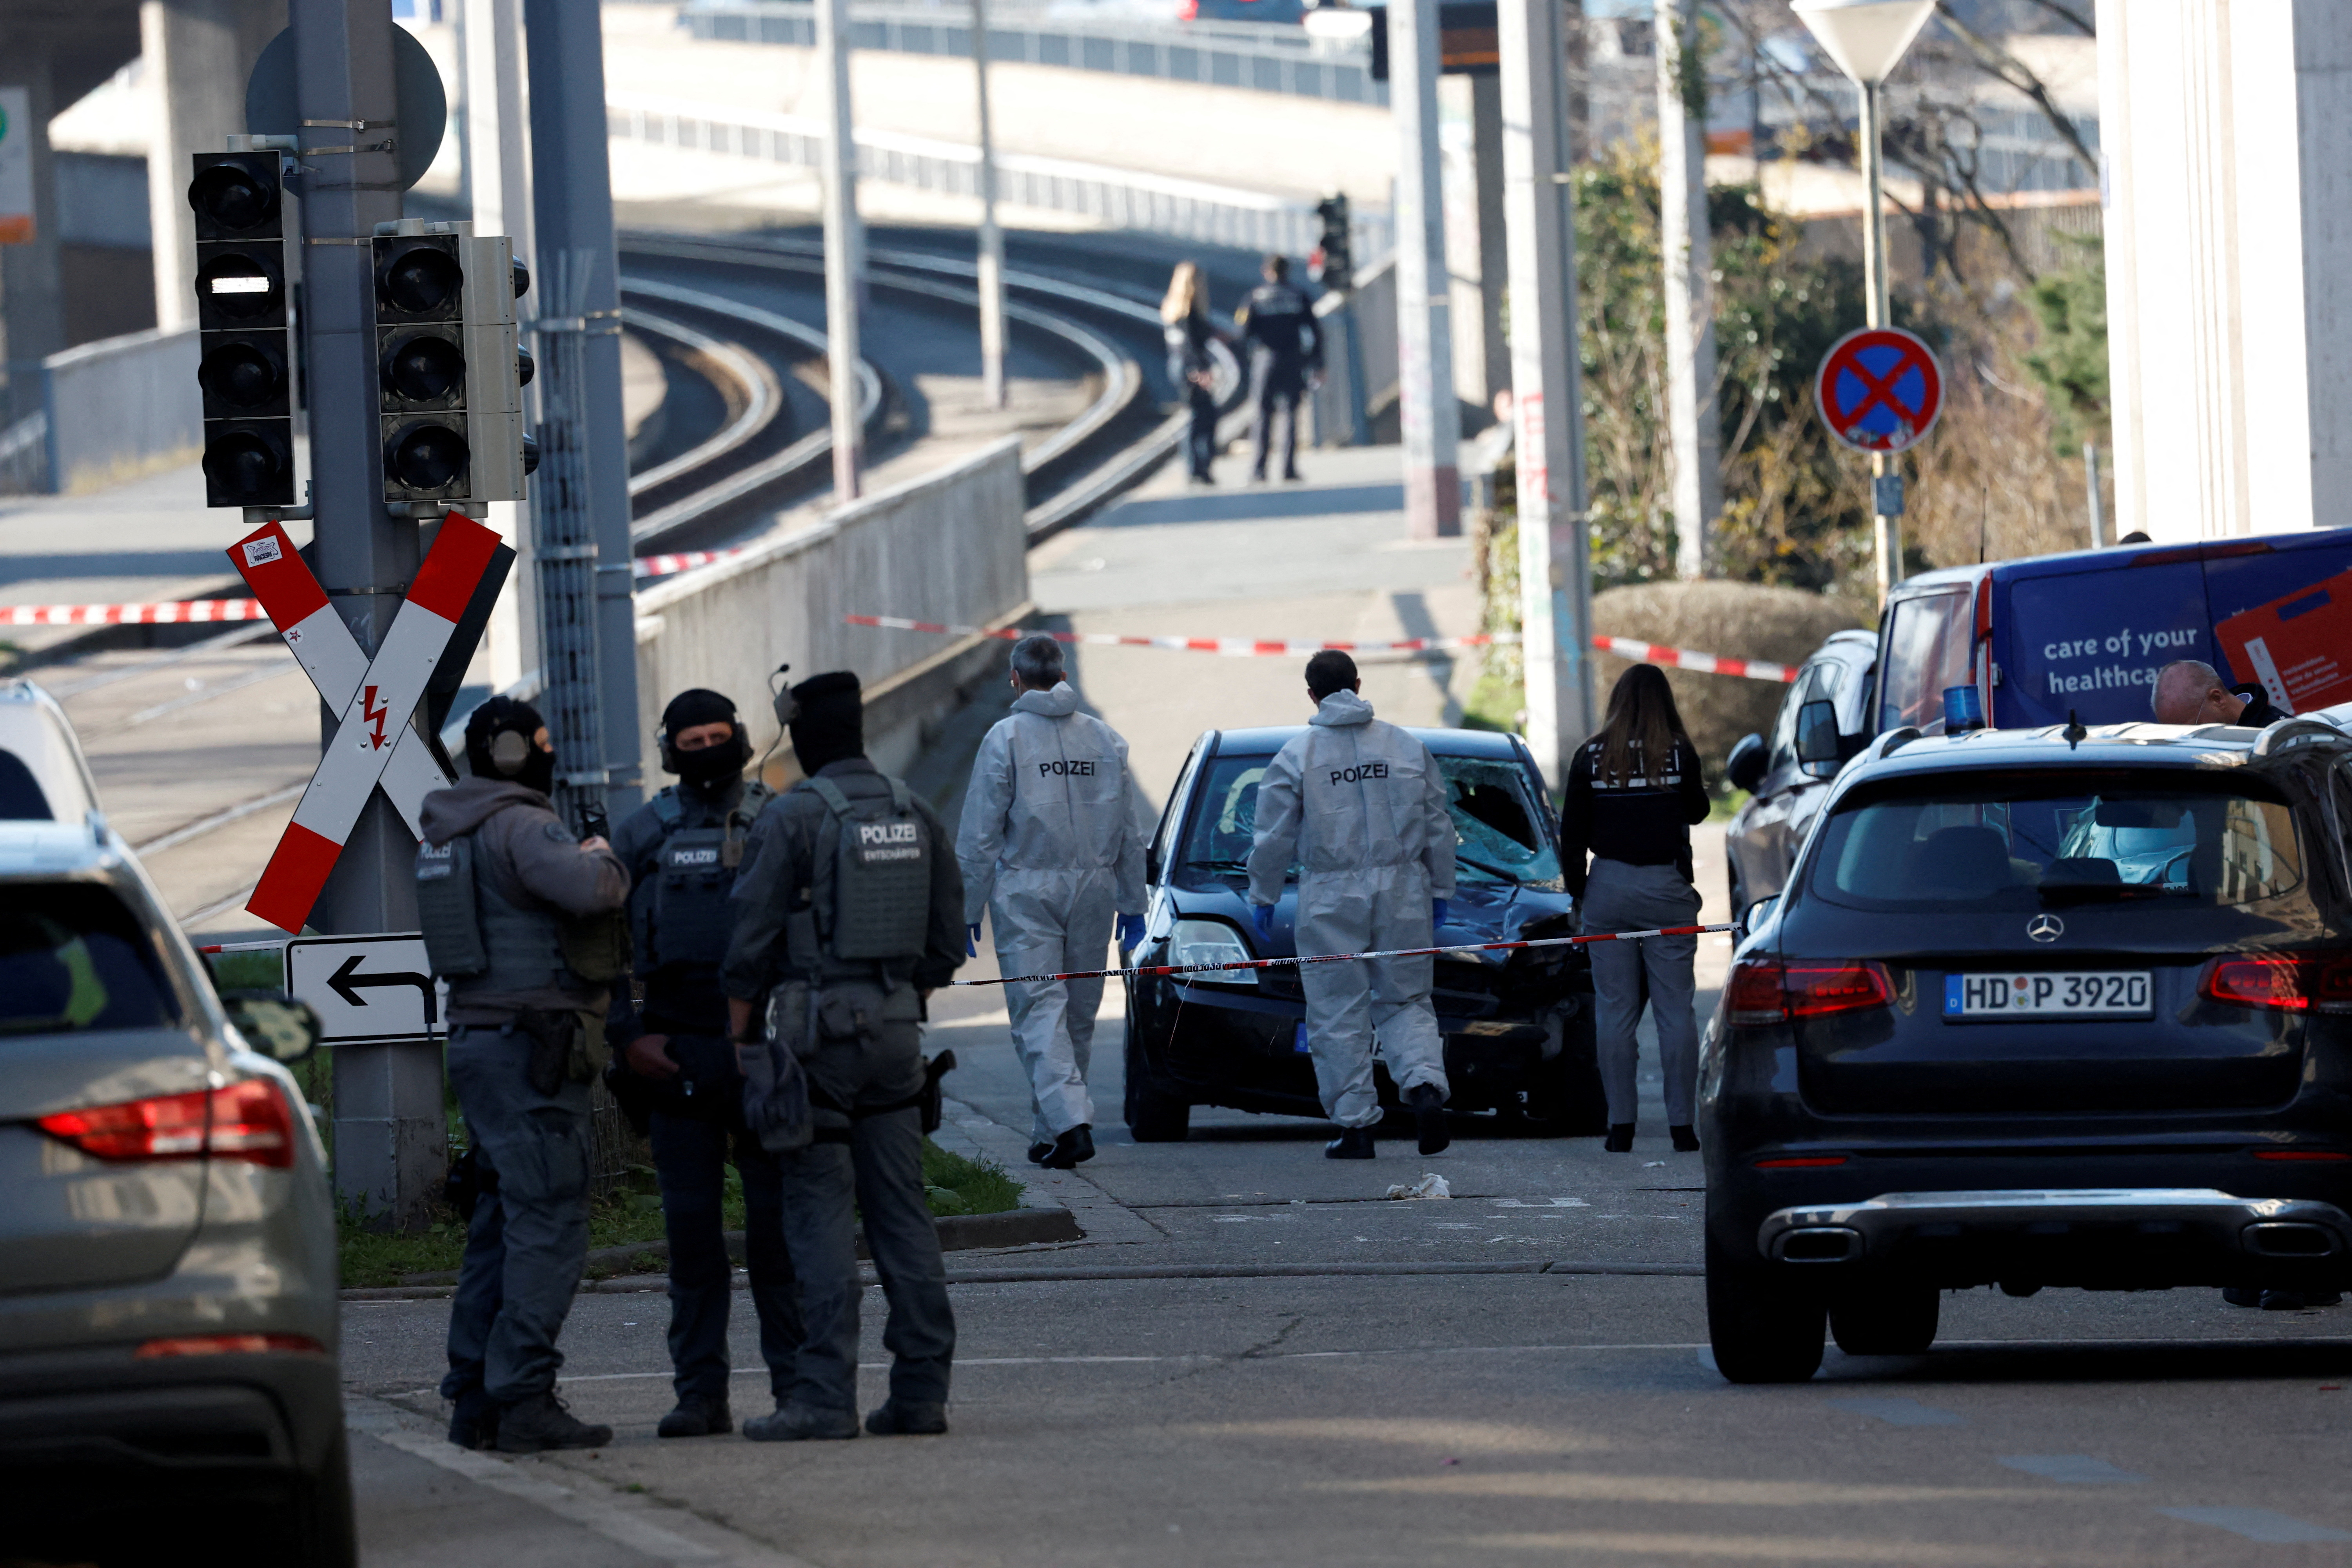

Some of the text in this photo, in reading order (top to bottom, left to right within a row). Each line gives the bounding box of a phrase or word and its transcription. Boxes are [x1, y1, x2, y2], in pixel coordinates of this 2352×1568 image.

[2044, 629, 2197, 660] care of your
[2049, 665, 2158, 694] healthca
[1039, 760, 1095, 777] POIZEI
[1330, 764, 1388, 786] POIZEI
[860, 824, 917, 845] POLIZEI
[675, 849, 717, 864] POLIZEI
[1950, 998, 1958, 1008] D
[1966, 976, 2146, 1009] HD P 3920
